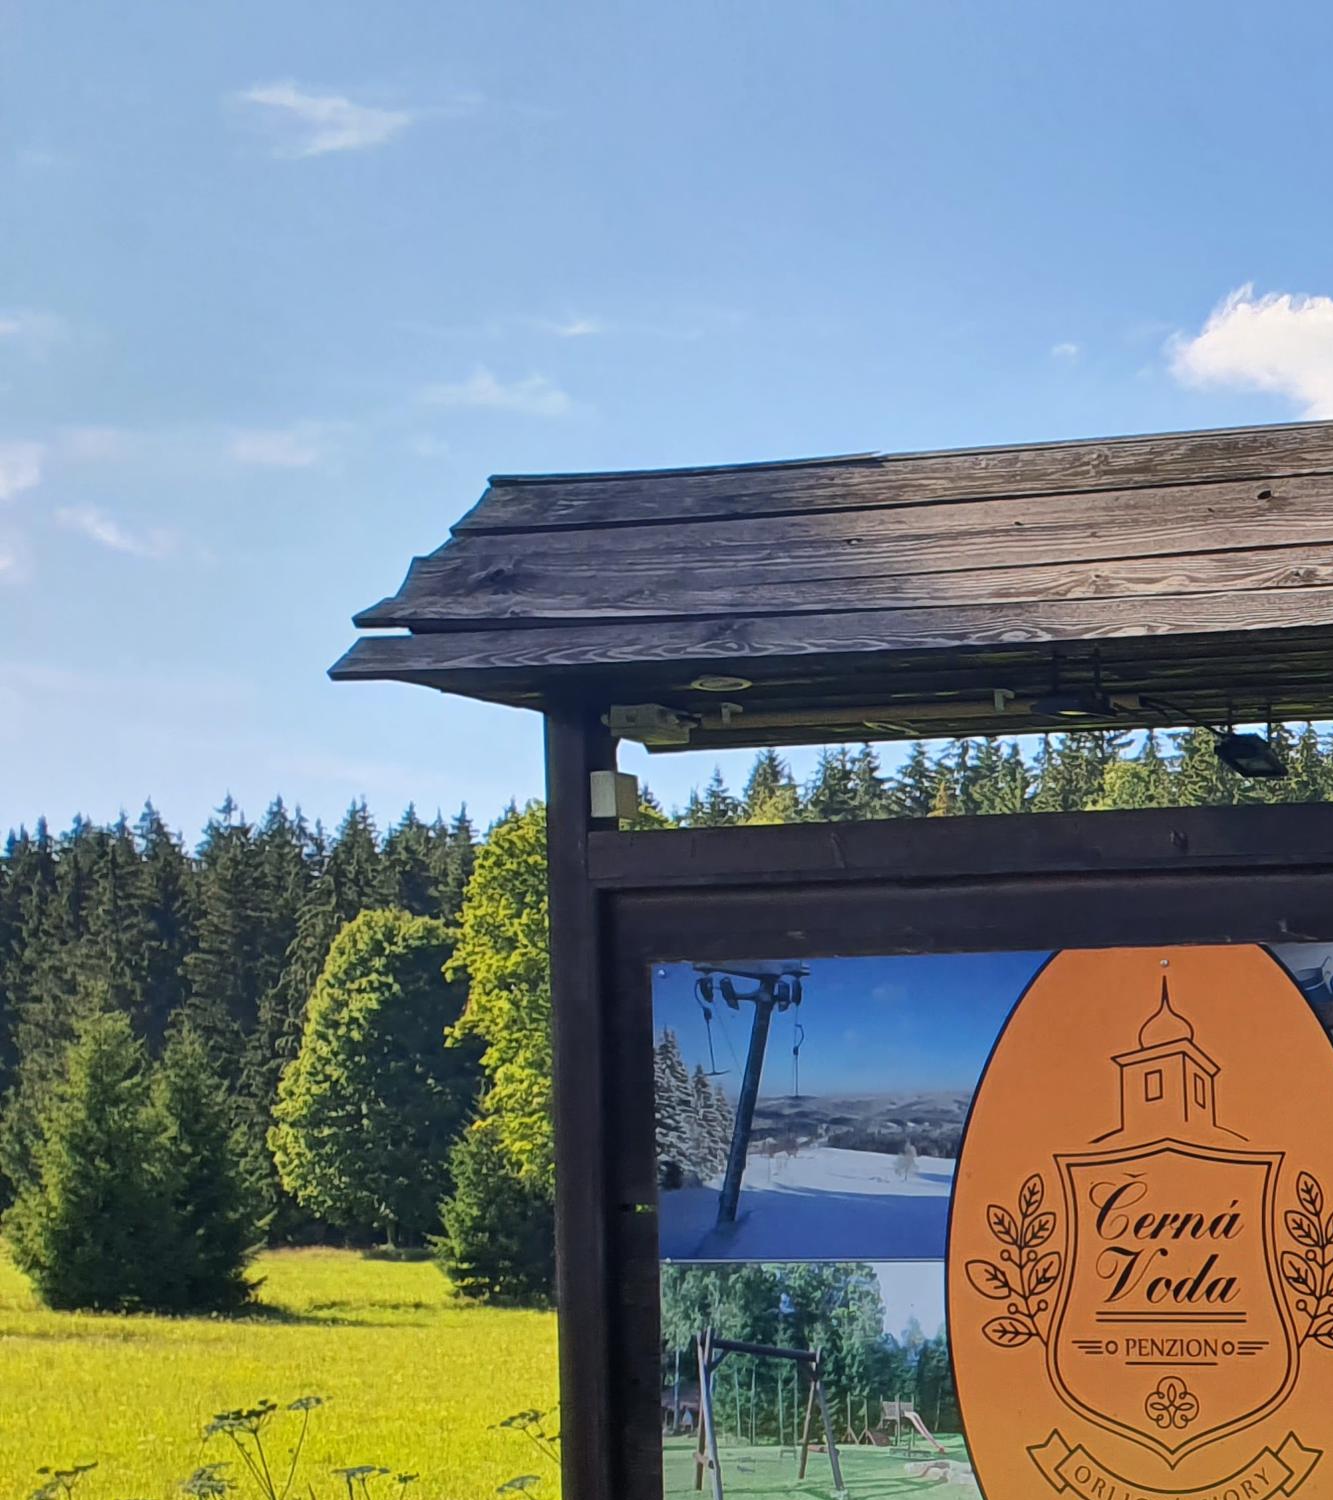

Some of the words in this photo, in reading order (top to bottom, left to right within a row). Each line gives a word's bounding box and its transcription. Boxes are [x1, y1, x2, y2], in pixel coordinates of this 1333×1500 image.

[1089, 1172, 1245, 1241] Černá
[1095, 1246, 1241, 1304] Voda
[1125, 1338, 1218, 1357] PENZION
